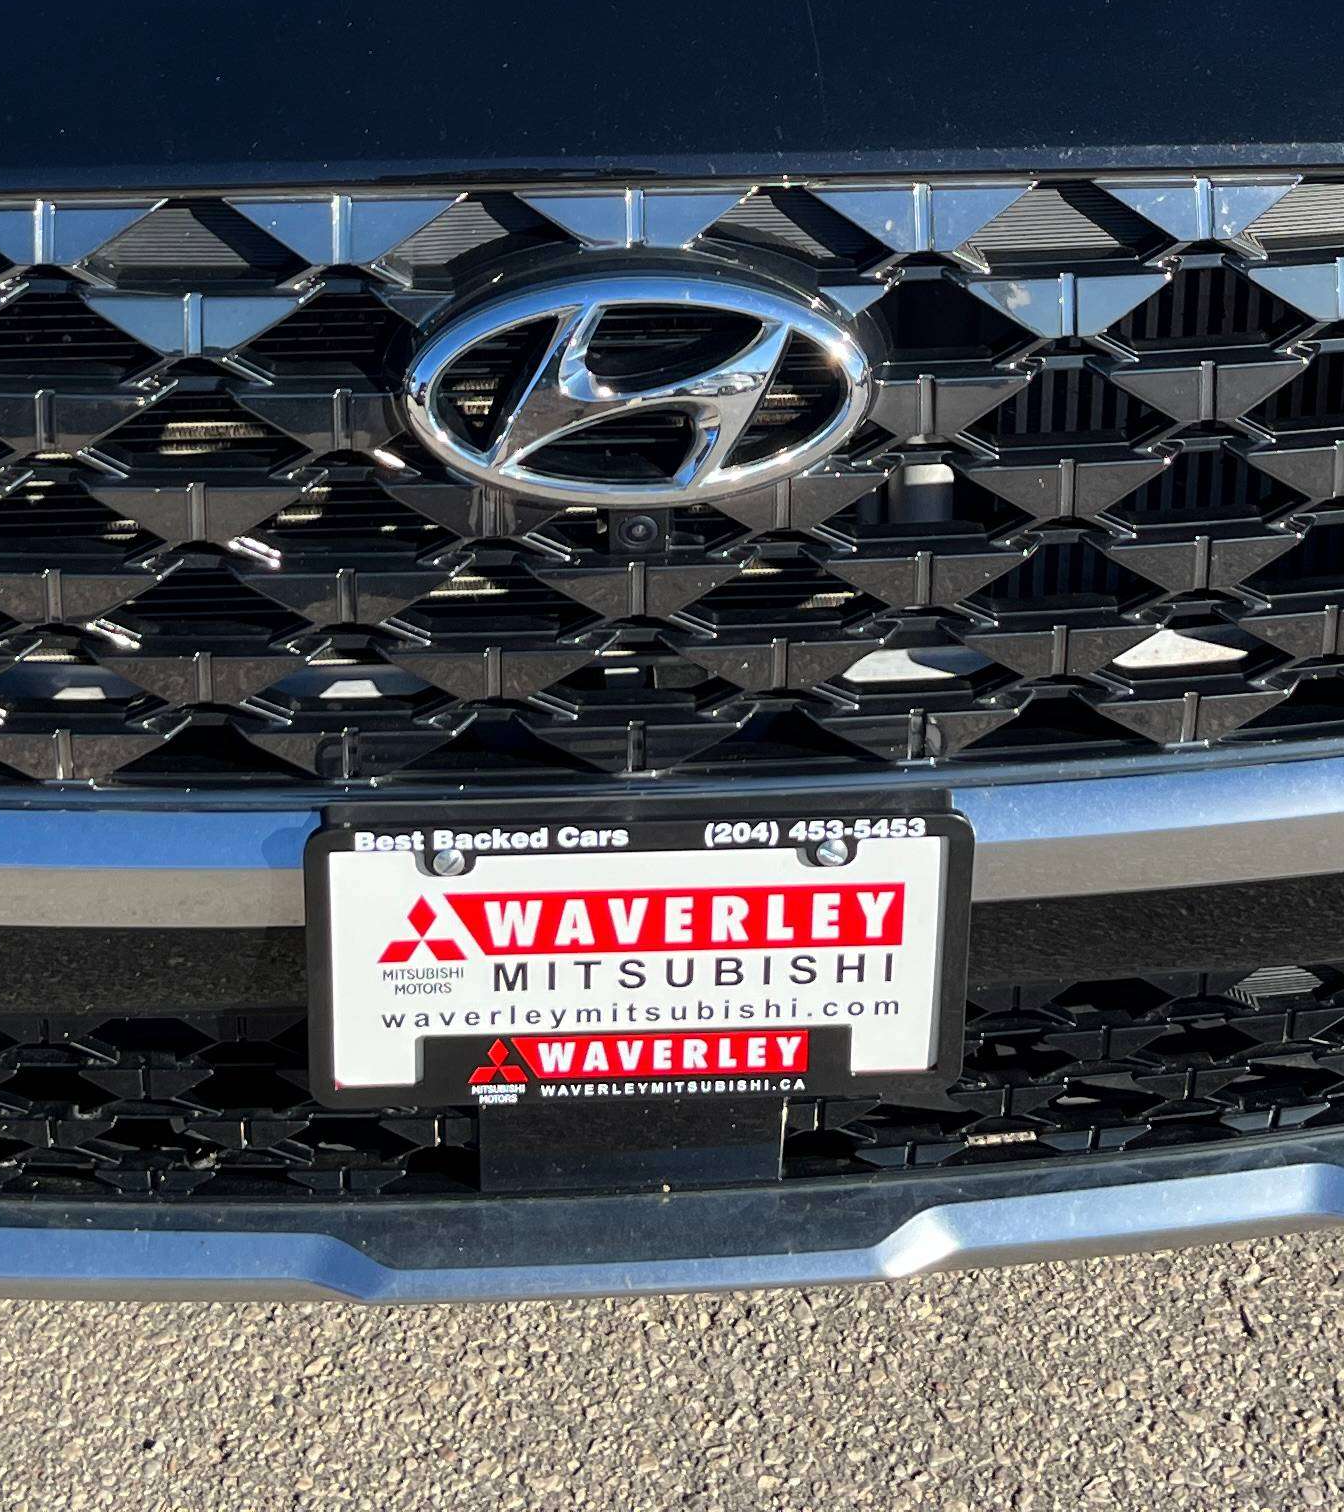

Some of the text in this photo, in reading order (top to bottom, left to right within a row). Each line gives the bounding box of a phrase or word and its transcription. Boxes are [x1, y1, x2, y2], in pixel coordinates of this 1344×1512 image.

[355, 826, 630, 851] Best Backed Cars
[705, 817, 927, 848] (204) 453-5453
[483, 891, 896, 949] WAVERLEY
[382, 966, 465, 981] MITSUBISHI
[493, 952, 893, 992] MITSUBISHI
[394, 982, 453, 996] MOTORS
[381, 998, 900, 1029] waverleymitsubishi.com
[537, 1036, 802, 1073] WAVERLEY
[471, 1084, 527, 1095] MITSUBISHI
[478, 1093, 519, 1104] MOTORS
[540, 1078, 806, 1097] WAVERLEYMITSUBISHI.CA
